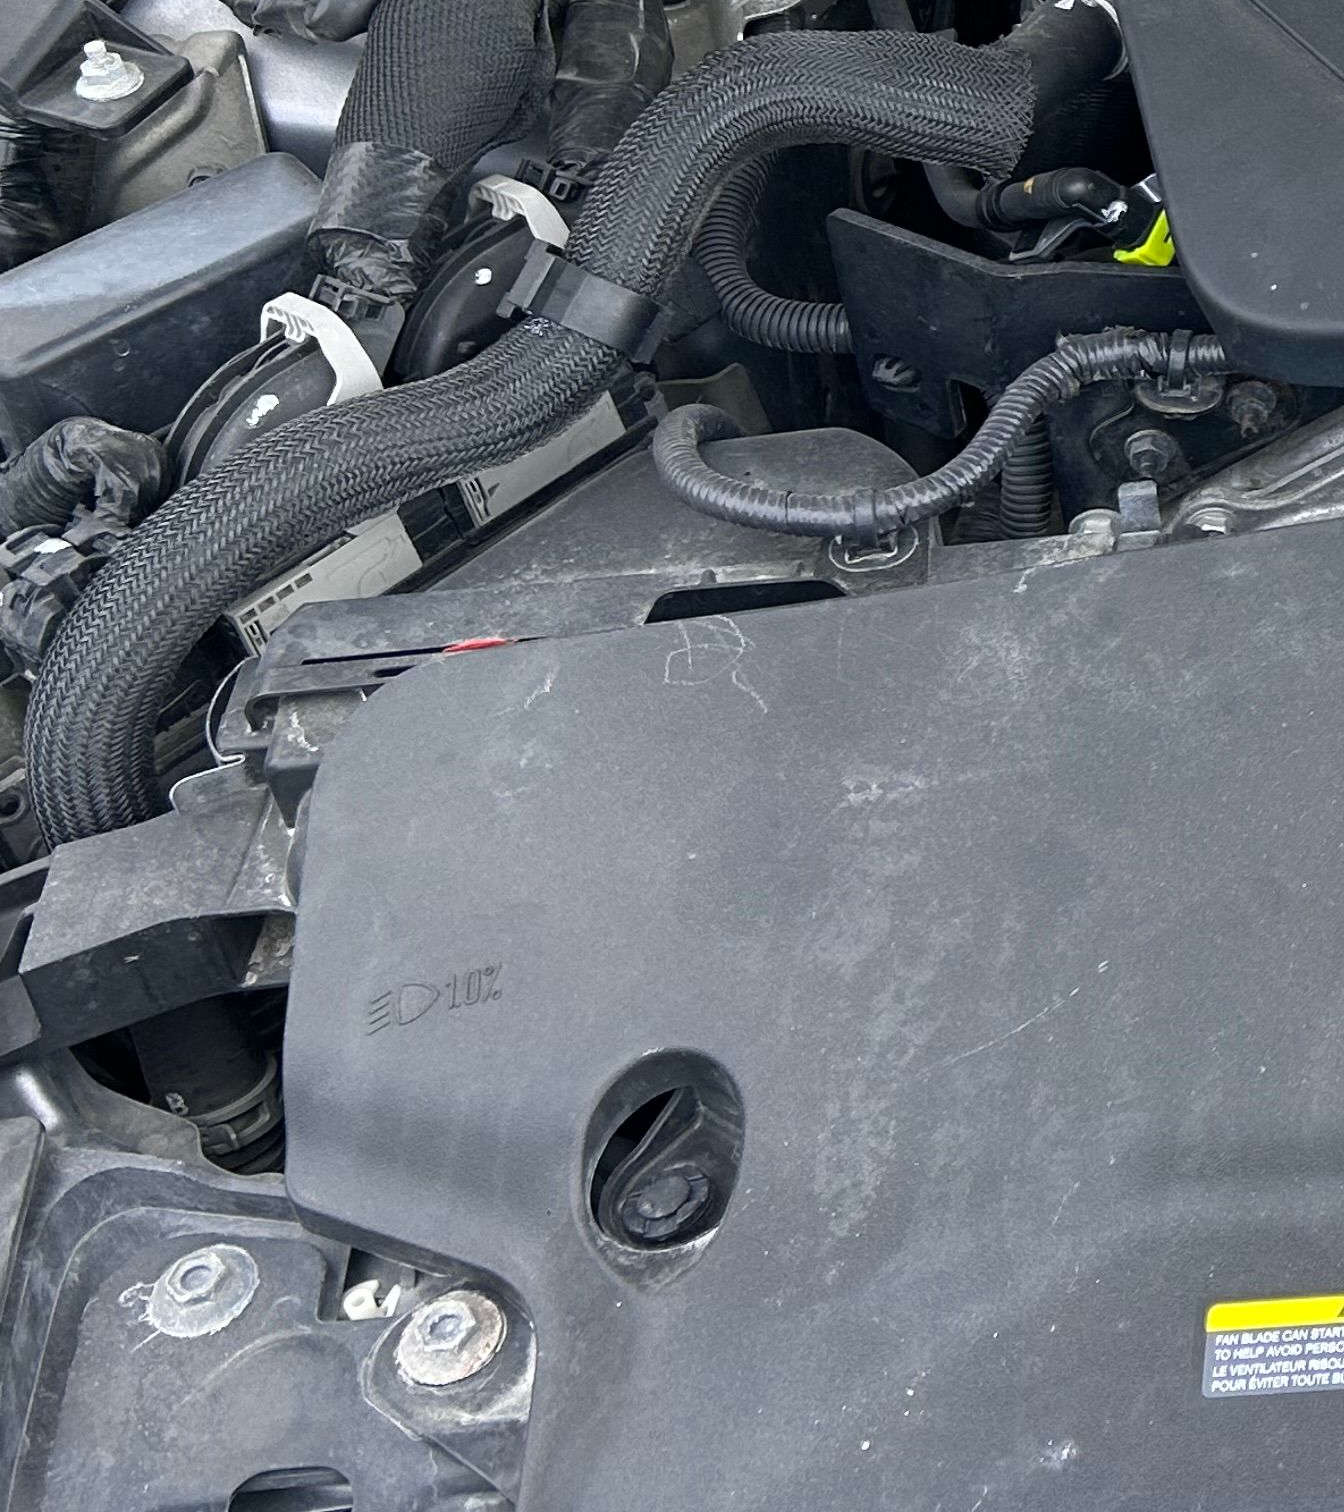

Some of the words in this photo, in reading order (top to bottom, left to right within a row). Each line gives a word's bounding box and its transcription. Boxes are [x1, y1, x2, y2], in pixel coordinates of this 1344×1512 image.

[1215, 1334, 1239, 1346] FAN
[1241, 1332, 1280, 1345] BLADE
[1282, 1329, 1308, 1341] CAN
[1214, 1349, 1231, 1361] TO
[1233, 1347, 1265, 1360] HELP
[1265, 1344, 1303, 1359] AVOID
[1212, 1365, 1228, 1378] LE
[1229, 1359, 1306, 1377] VENTILATEUR
[1211, 1379, 1248, 1393] POUR
[1249, 1375, 1290, 1390] ÉVITER
[1291, 1372, 1330, 1387] TOUTE
